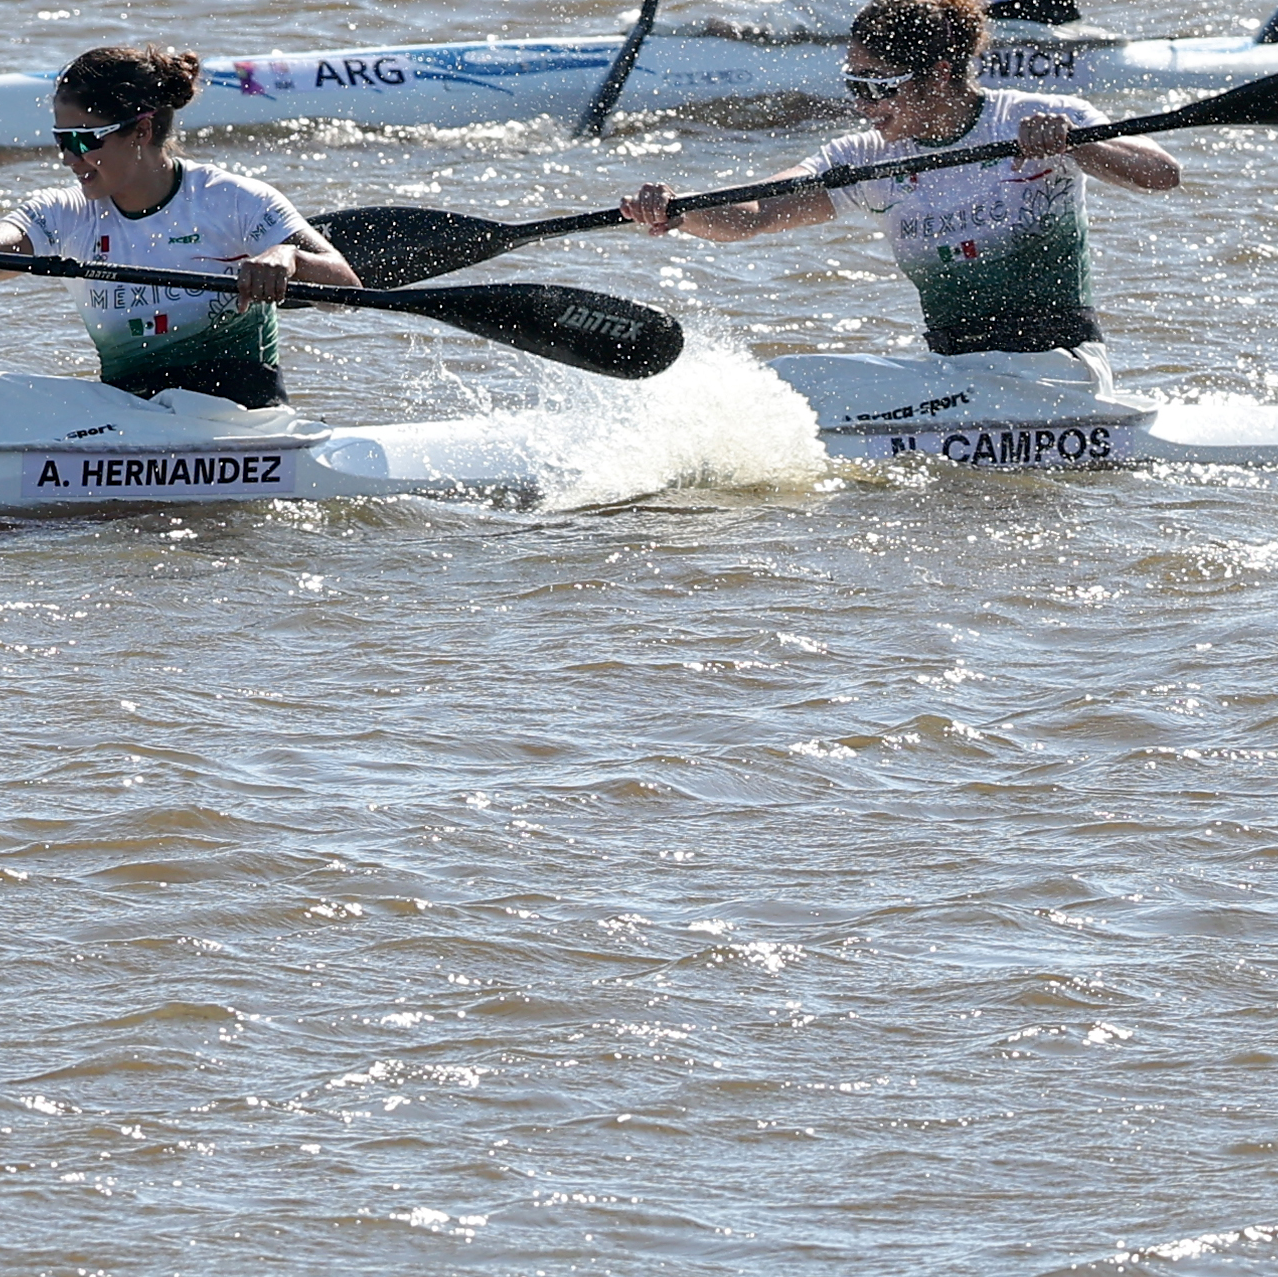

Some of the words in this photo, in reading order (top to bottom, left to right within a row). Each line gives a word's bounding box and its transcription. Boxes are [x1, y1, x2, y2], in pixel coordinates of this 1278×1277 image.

[315, 57, 406, 88] ARG
[942, 427, 1111, 465] CAMPOS
[37, 459, 70, 487] A.
[81, 455, 282, 487] HERNANDEZ
